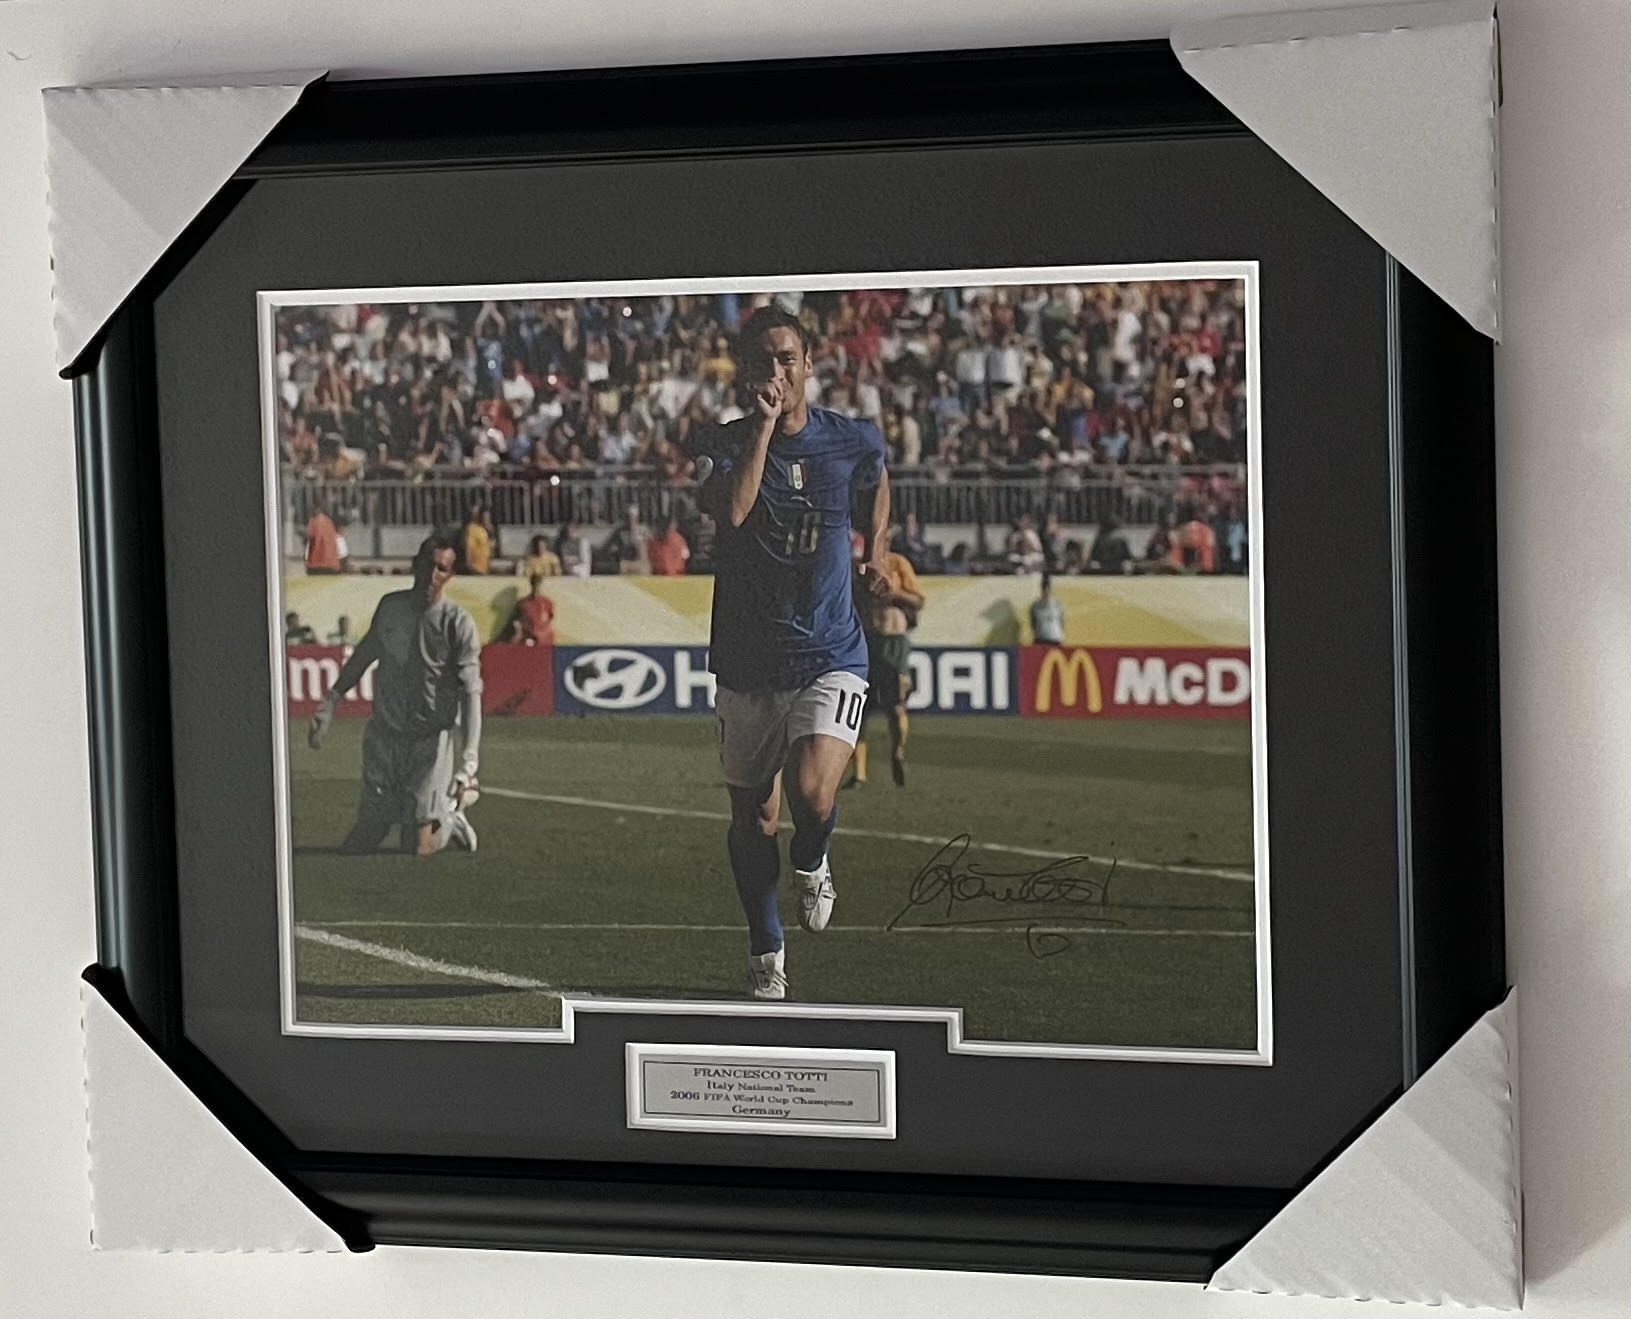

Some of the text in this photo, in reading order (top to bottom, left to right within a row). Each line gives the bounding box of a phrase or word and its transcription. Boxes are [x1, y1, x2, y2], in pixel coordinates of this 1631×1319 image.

[1113, 657, 1251, 706] McD
[834, 688, 863, 731] 10
[693, 1067, 828, 1082] FRANCESCO TOTTI
[707, 1080, 816, 1094] Italy National Team
[670, 1090, 700, 1101] 2006
[703, 1092, 731, 1102] FIFA
[733, 1094, 765, 1103] World
[767, 1095, 790, 1106] Cup
[731, 1104, 791, 1118] Germany
